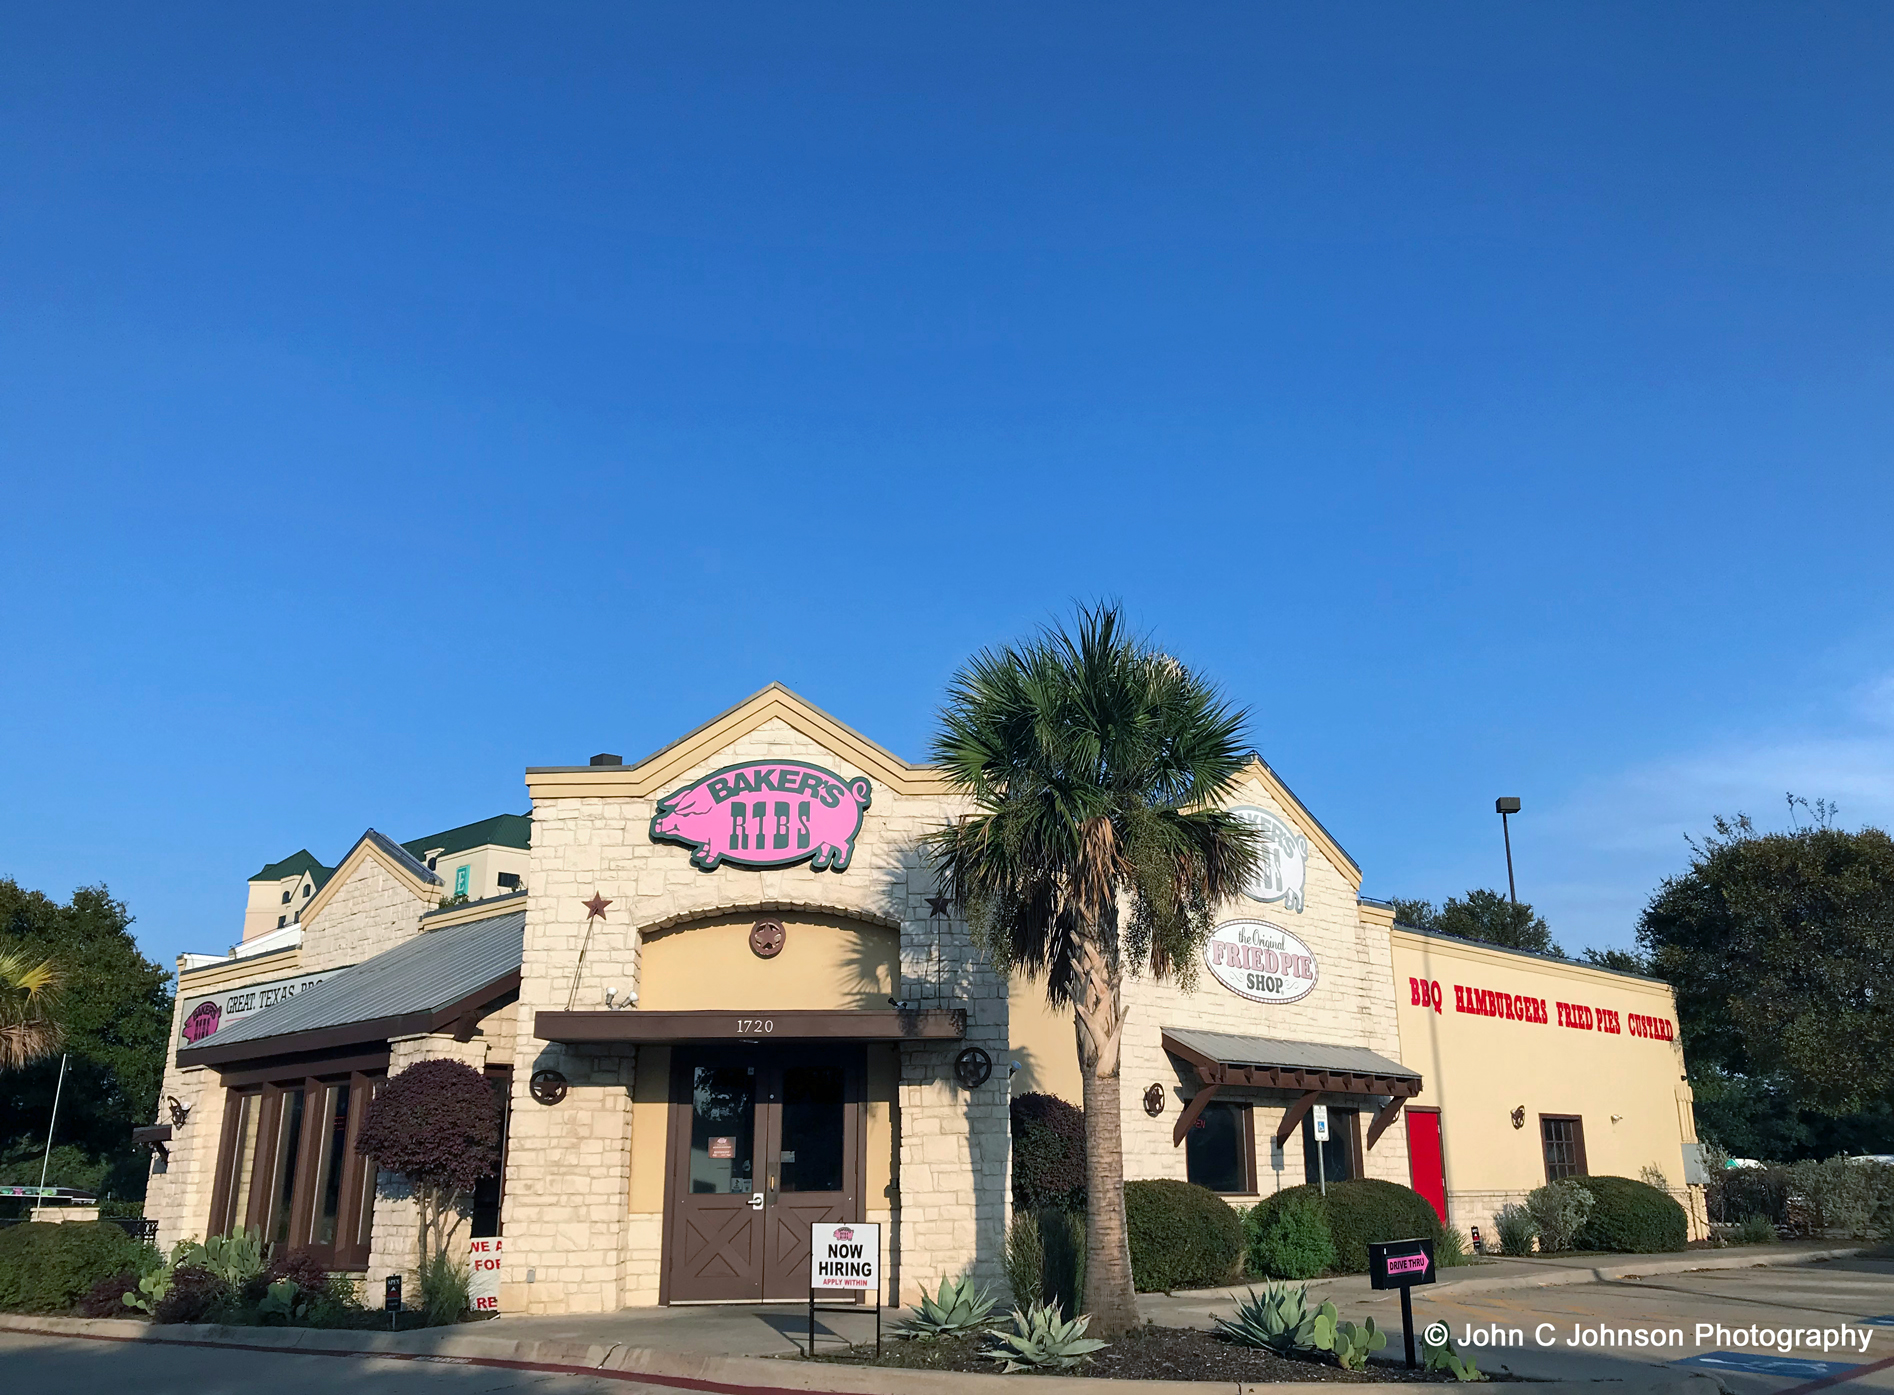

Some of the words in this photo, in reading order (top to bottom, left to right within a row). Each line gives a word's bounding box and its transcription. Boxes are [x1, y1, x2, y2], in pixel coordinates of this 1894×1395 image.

[706, 769, 845, 808] BAKER'S
[729, 801, 811, 849] RIBS
[1238, 926, 1252, 944] the
[1252, 929, 1286, 954] Original
[1211, 940, 1279, 974] FRIED
[1279, 951, 1314, 980] PIE
[1246, 972, 1284, 994] SHOP
[1409, 977, 1443, 1015] BBQ
[1454, 985, 1548, 1024] HAMBURGERS
[1556, 1001, 1593, 1030] FRIED
[1595, 1007, 1621, 1034] PIES
[1628, 1012, 1674, 1042] CUSTARD
[736, 1019, 774, 1033] 1720
[828, 1244, 863, 1259] NOW
[819, 1261, 872, 1277] HIRING
[1390, 1259, 1407, 1271] DRIVE
[1408, 1257, 1425, 1268] THRU
[823, 1278, 843, 1286] APPLY
[844, 1279, 868, 1287] WITHIN
